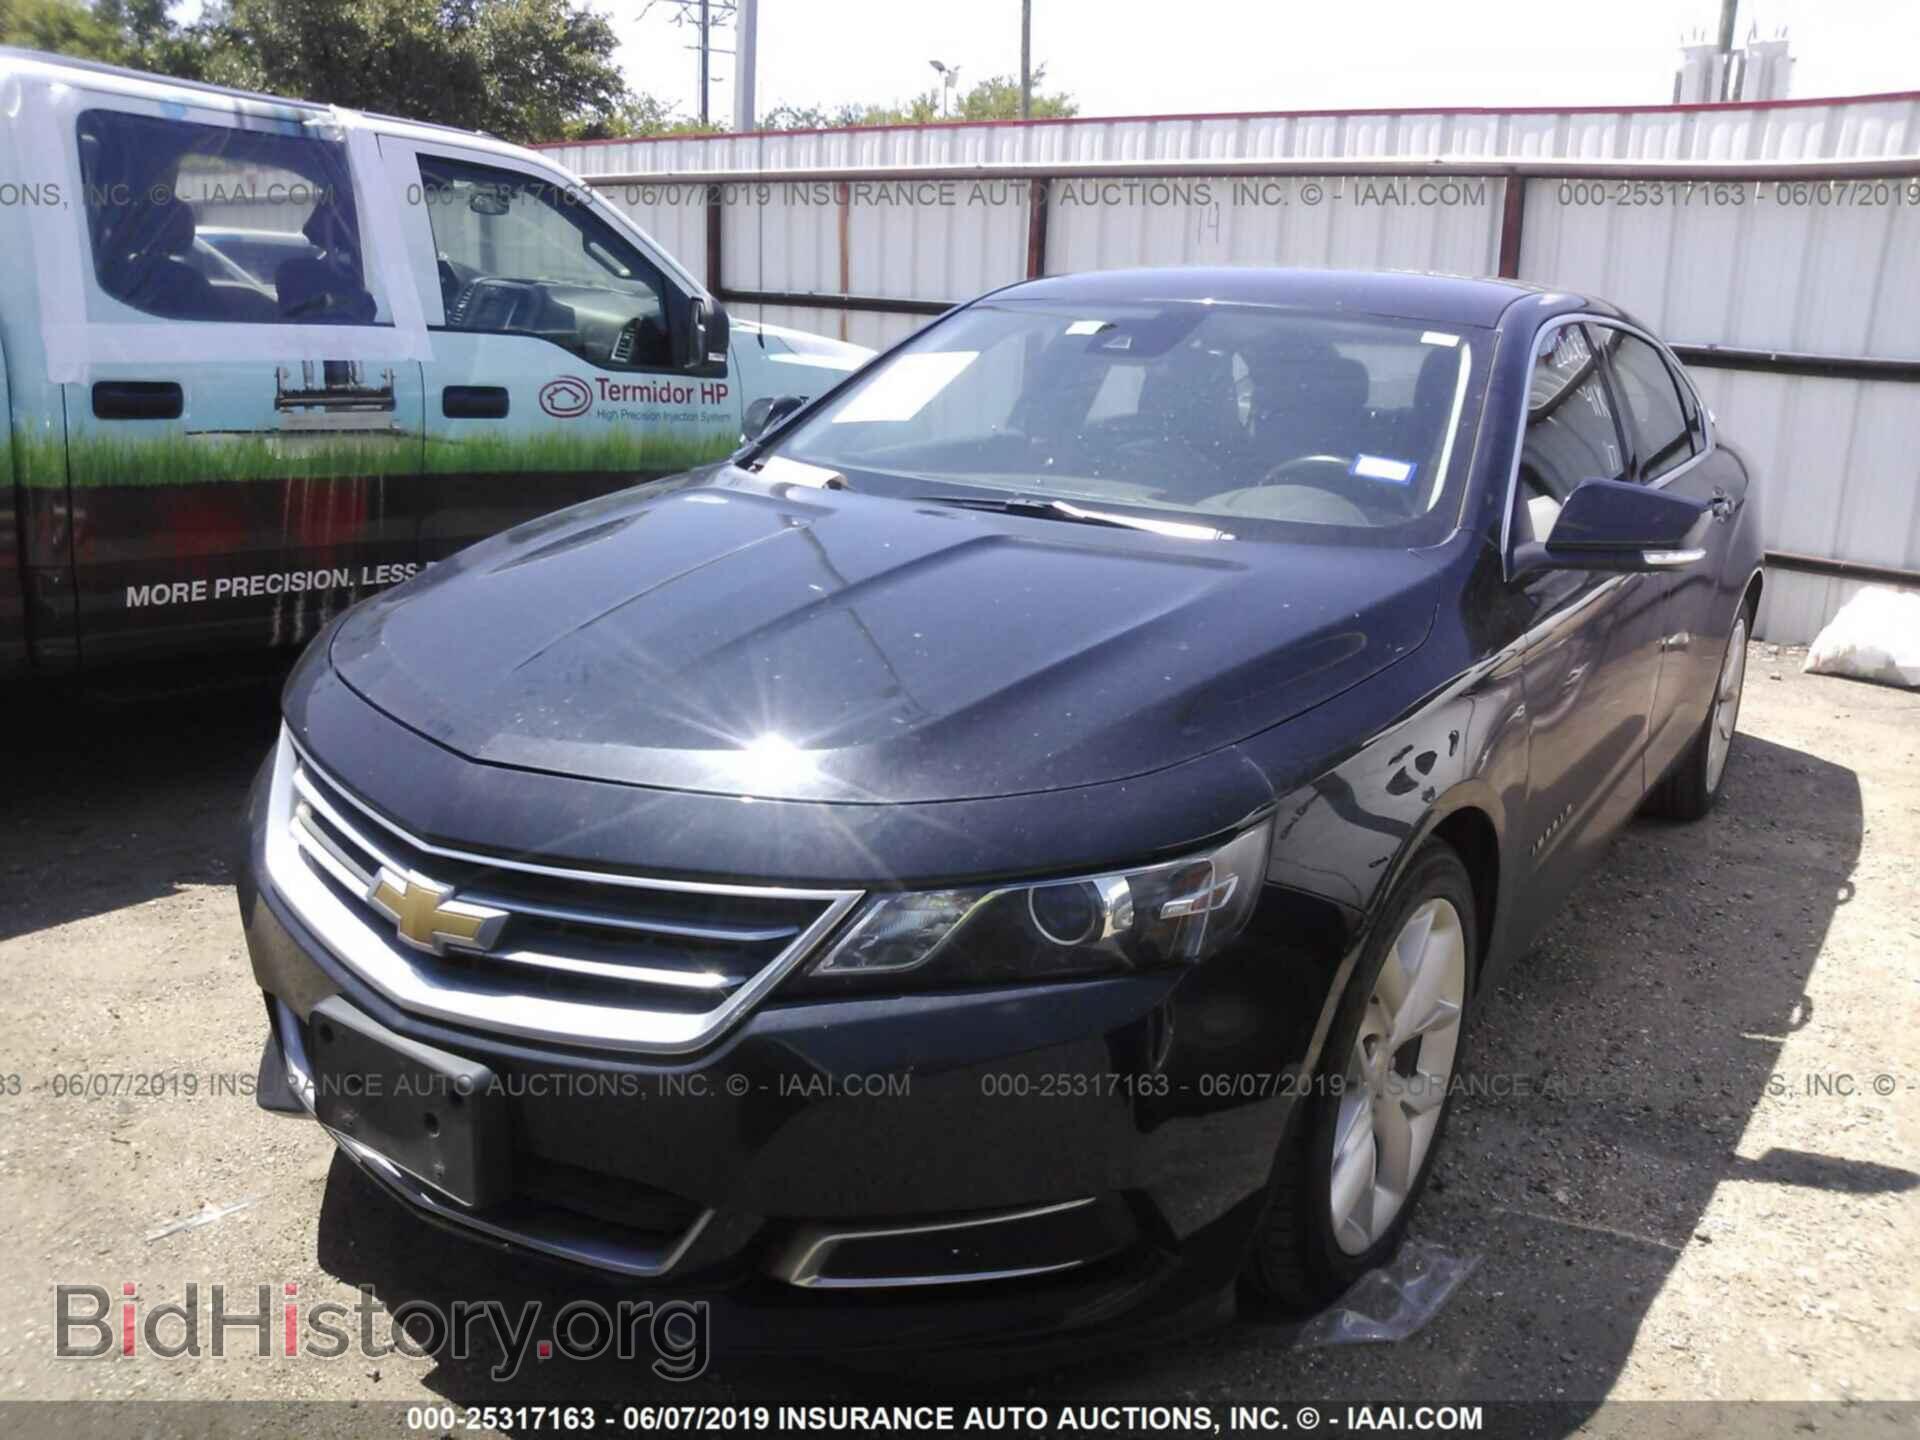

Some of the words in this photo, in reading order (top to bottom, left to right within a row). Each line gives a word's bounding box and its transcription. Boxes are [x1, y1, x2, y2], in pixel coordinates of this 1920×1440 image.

[595, 377, 693, 405] Termidor
[701, 383, 728, 406] HP
[126, 581, 207, 608] MORE
[215, 567, 354, 599] PRECISION.
[362, 563, 418, 586] LESS
